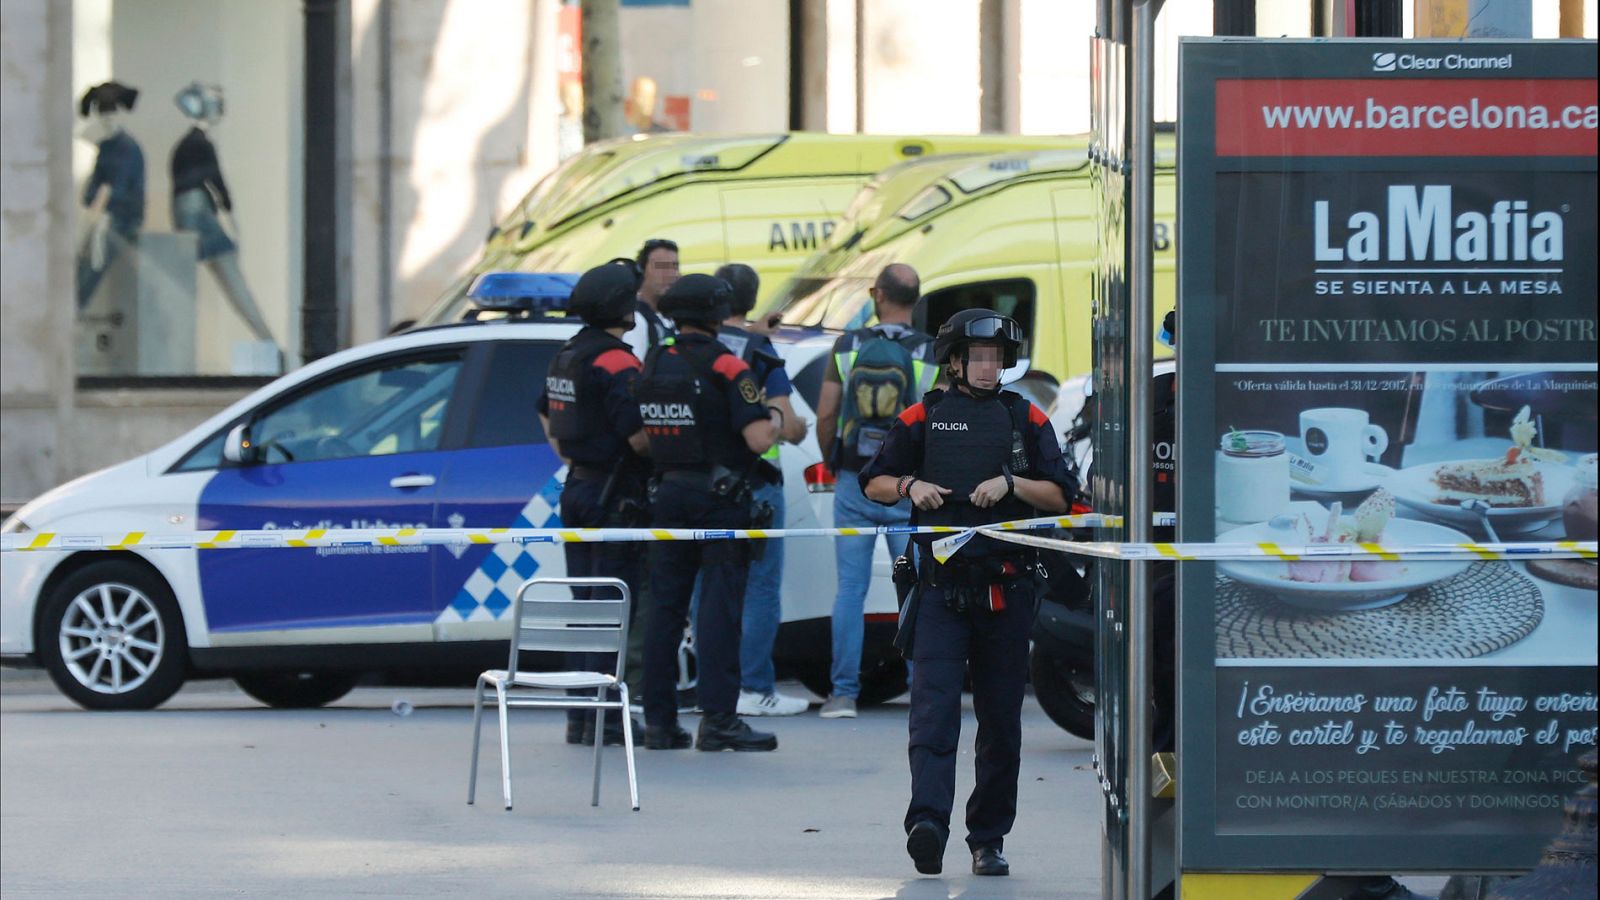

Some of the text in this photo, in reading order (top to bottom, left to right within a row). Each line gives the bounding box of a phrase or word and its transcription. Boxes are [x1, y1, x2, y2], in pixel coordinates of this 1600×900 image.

[1398, 53, 1512, 70] Clear Channel
[1262, 98, 1597, 129] www.barcelona.ca
[1315, 280, 1563, 295] SE SIENTA A LA MESA
[1259, 318, 1597, 343] TE INVITAMOS AL POSTR
[1274, 379, 1305, 391] válida
[1308, 379, 1337, 391] hasta
[1339, 379, 1350, 391] el
[1527, 379, 1541, 391] La
[639, 403, 694, 419] POLICIA
[931, 422, 969, 431] POLICIA
[1375, 695, 1418, 712] una
[1423, 686, 1469, 722] foto
[1476, 686, 1528, 722] tuya
[1535, 691, 1597, 712] enseñ
[1237, 720, 1281, 746] este
[1289, 720, 1354, 746] cartel
[1356, 730, 1381, 755] y
[1384, 720, 1408, 745] te
[1414, 720, 1529, 754] regalamos
[1535, 719, 1559, 745] el
[1246, 771, 1285, 784] DEJA
[1289, 771, 1300, 784] A
[1305, 771, 1334, 784] LOS
[1338, 771, 1399, 784] PEQUES
[1403, 770, 1423, 784] EN
[1428, 770, 1498, 784] NUESTRA
[1504, 770, 1549, 784] ZONA
[1236, 795, 1272, 809] CON
[1277, 795, 1369, 811] MONITOR/A
[1373, 792, 1451, 811] (SÁBADOS
[1454, 795, 1466, 809] Y
[1471, 795, 1559, 809] DOMINGOS
